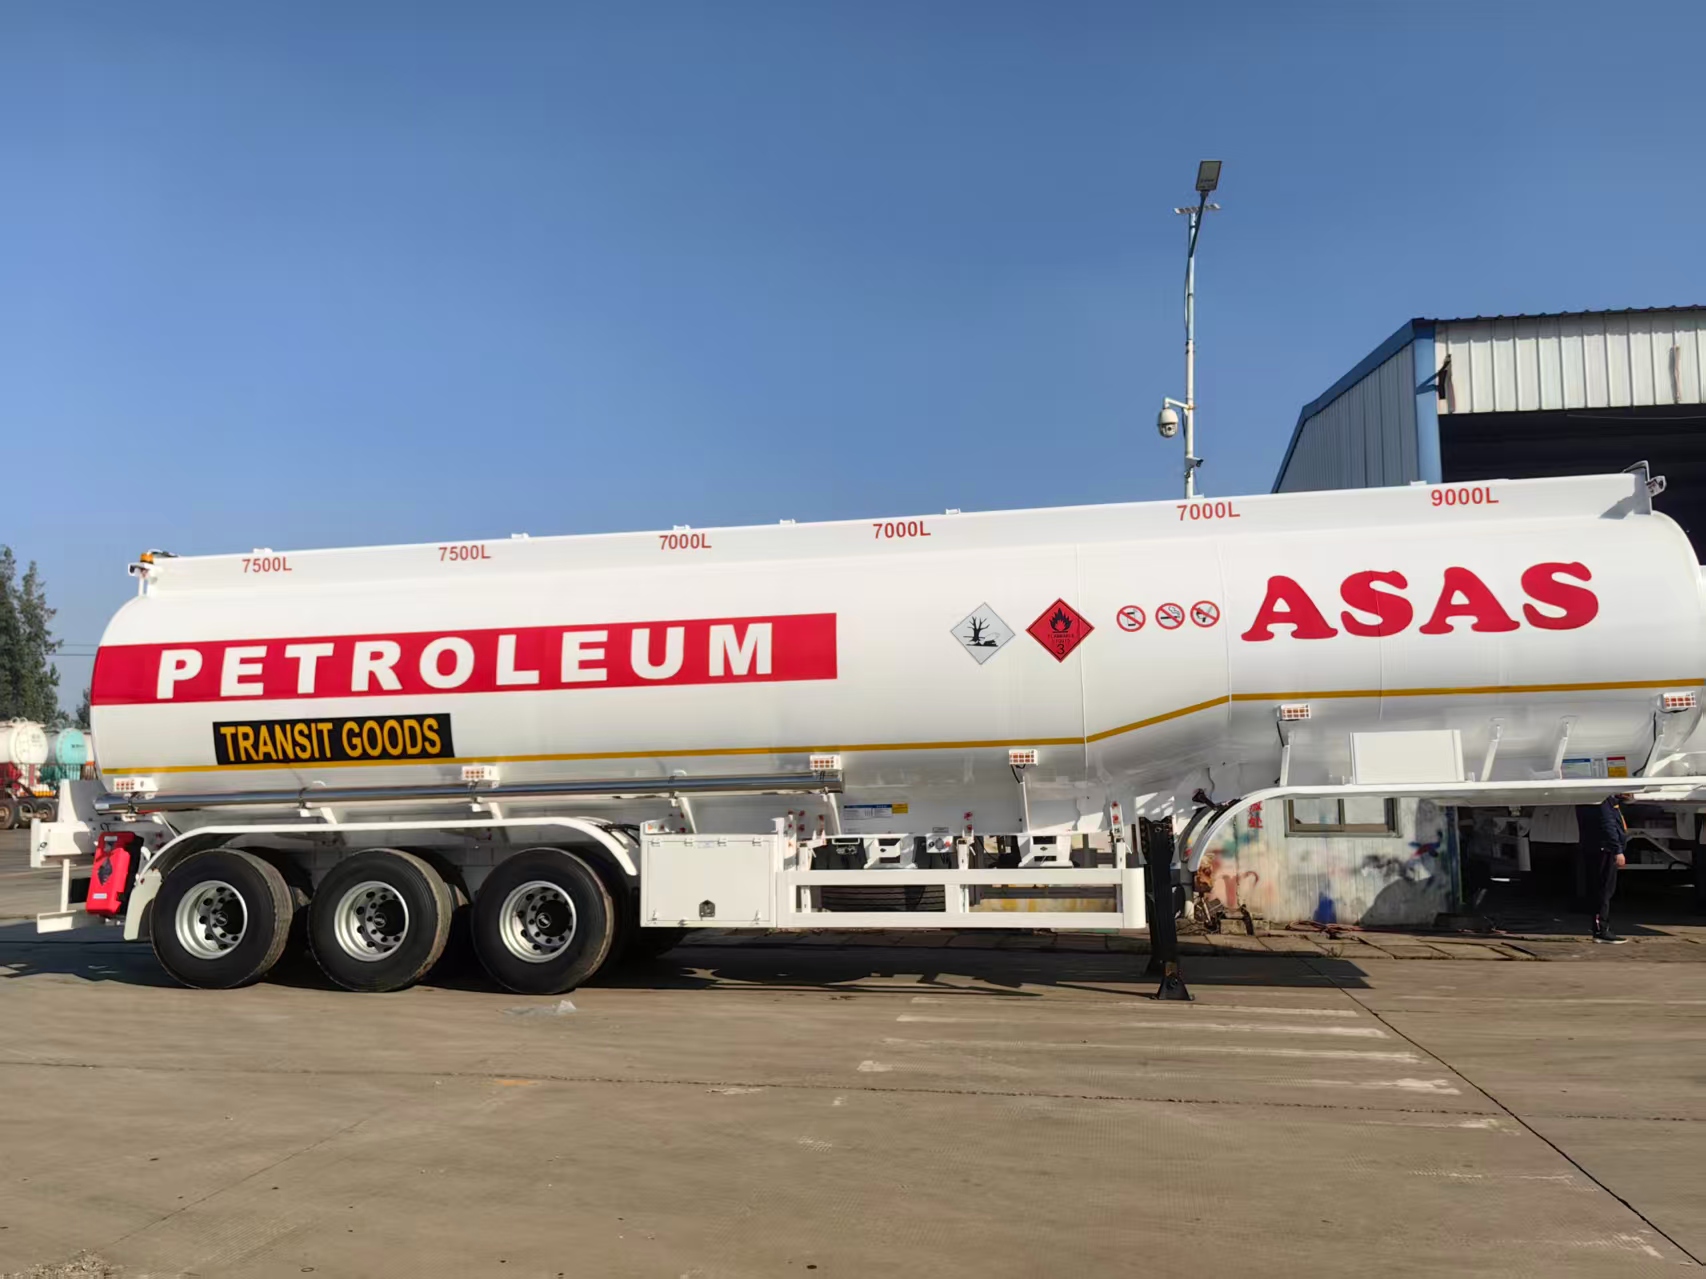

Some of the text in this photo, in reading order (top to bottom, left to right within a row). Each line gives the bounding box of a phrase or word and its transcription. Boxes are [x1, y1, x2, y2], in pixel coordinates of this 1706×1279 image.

[1431, 487, 1499, 507] 9000L
[1177, 501, 1241, 521] 7000L
[872, 520, 931, 539] 7000L
[659, 533, 712, 550] 7000L
[439, 544, 491, 562] 7500L
[242, 556, 292, 574] 7500L
[1241, 561, 1599, 642] ASAS
[1056, 643, 1065, 655] 3
[156, 622, 773, 699] PETROLEUM
[219, 717, 442, 762] TRANSIT GOODS
